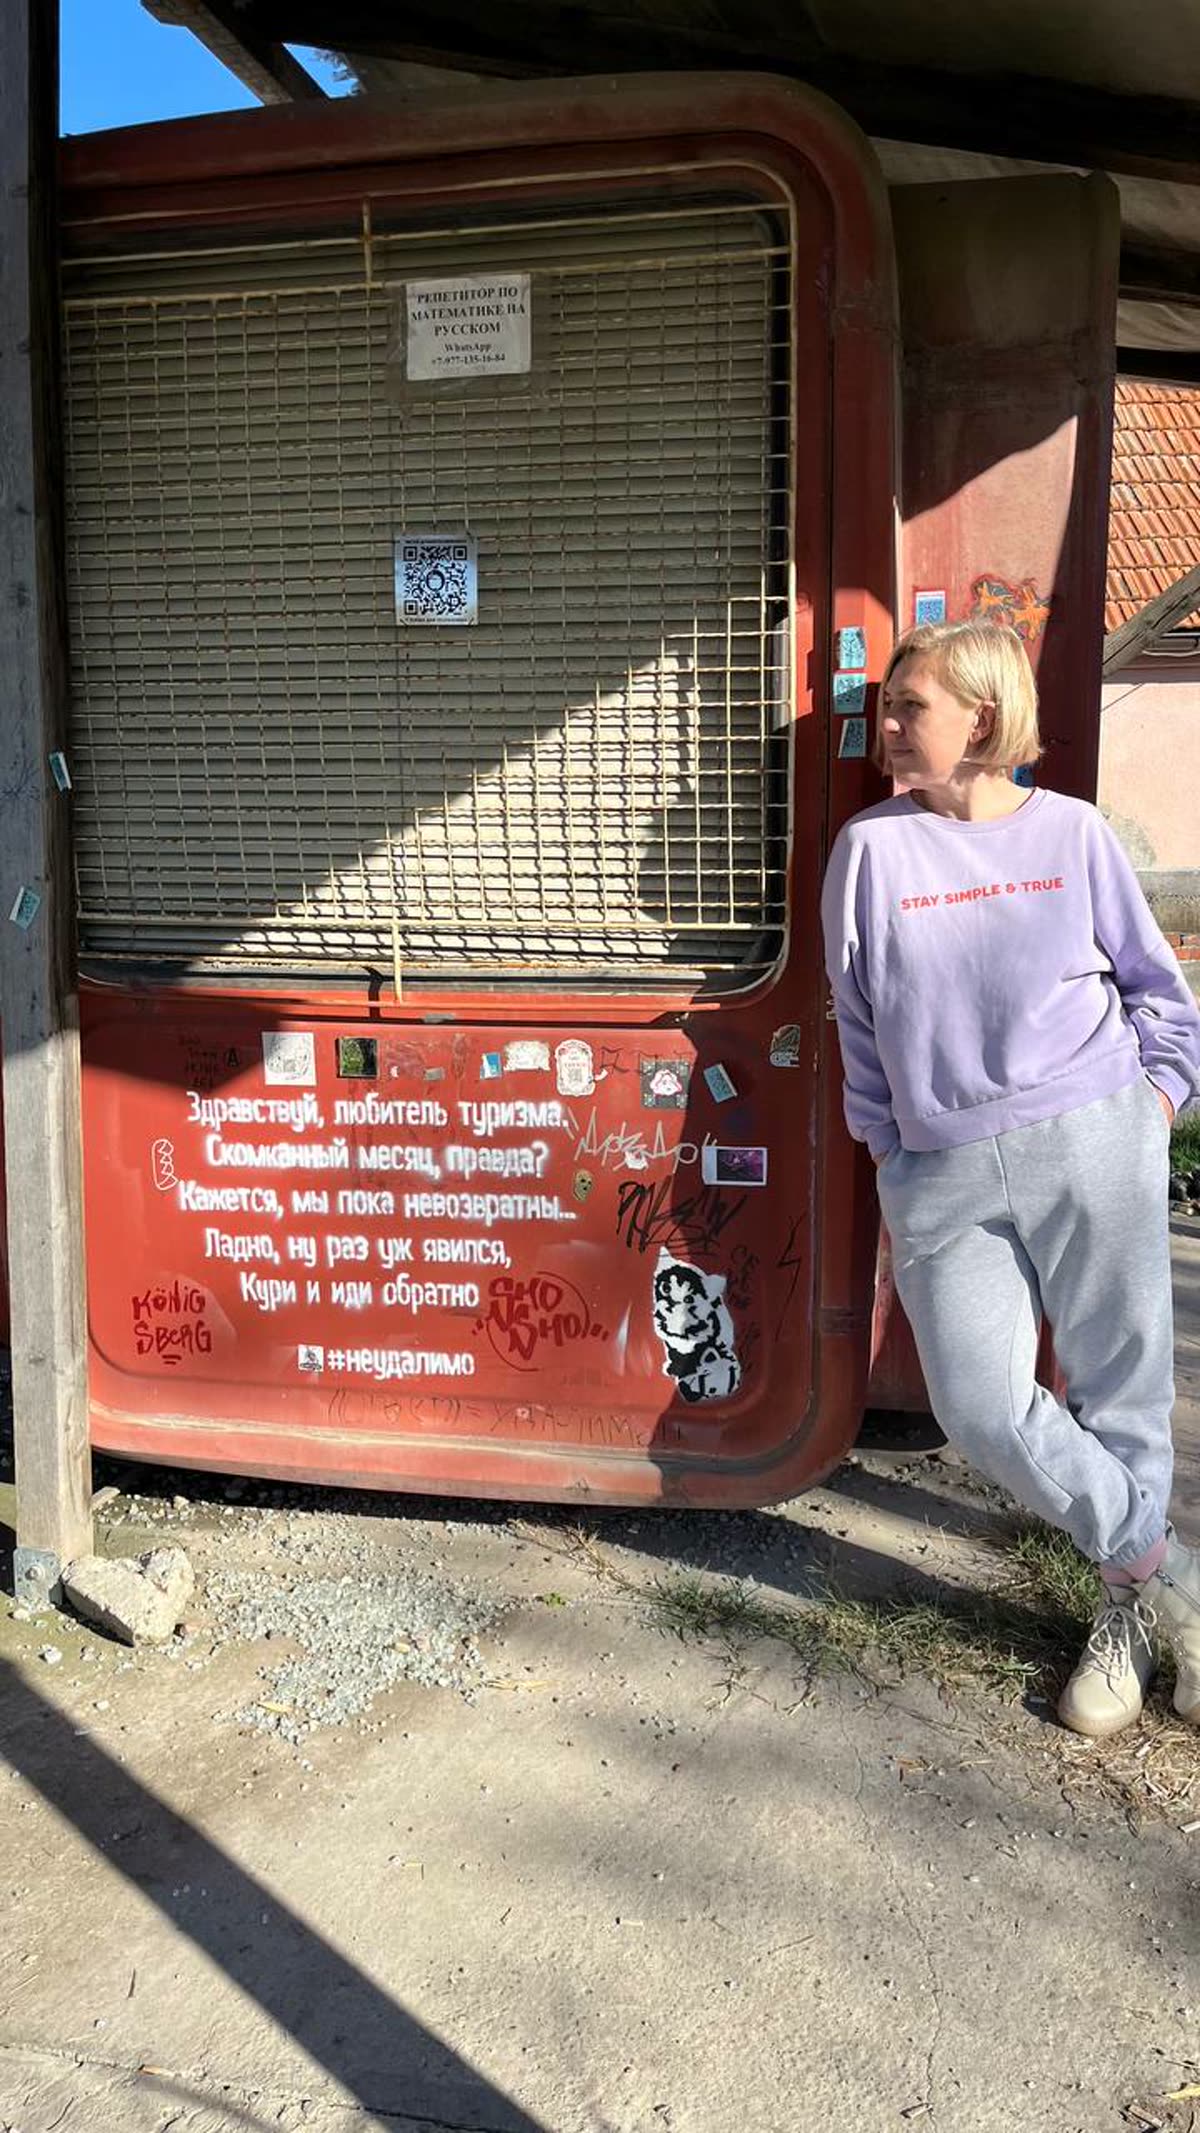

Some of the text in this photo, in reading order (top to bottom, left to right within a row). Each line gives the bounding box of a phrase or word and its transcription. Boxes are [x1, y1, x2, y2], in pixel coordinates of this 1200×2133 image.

[411, 303, 526, 321] МАТЕМАТИКЕ НА
[417, 286, 518, 304] РЕПЕТИТОР ПО
[434, 321, 501, 337] РУССКОМ
[443, 342, 492, 353] WhatsApp
[901, 877, 1064, 910] STAY SIMPLE & TRUE
[186, 1090, 570, 1137] Здравствуй, любитель туризма.
[205, 1132, 350, 1169] Скомканный
[358, 1143, 441, 1181] месяц,
[446, 1140, 549, 1181] правда?
[177, 1180, 577, 1228] Кажется, мы пока невозвратны...
[204, 1227, 512, 1269] Ладно, ну раз уж явился,
[239, 1271, 480, 1315] Кури и иди обратно
[326, 1347, 476, 1381] #неудалимо
